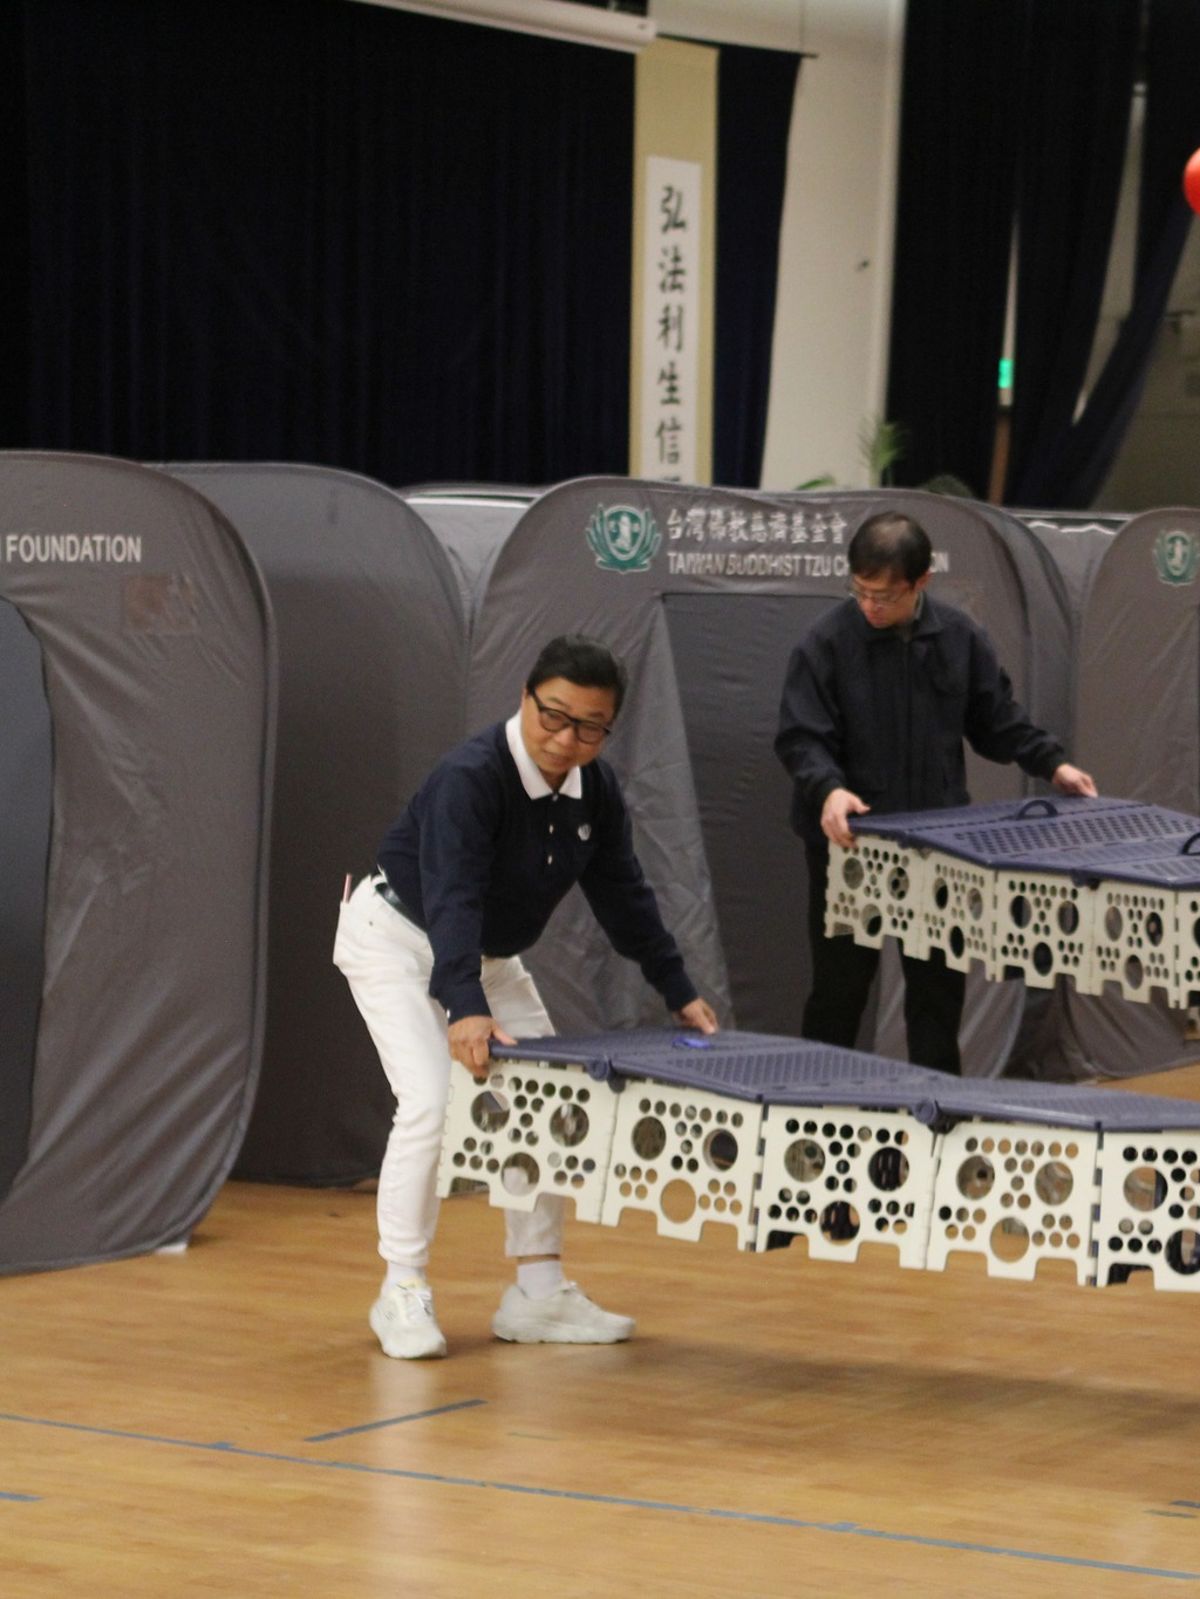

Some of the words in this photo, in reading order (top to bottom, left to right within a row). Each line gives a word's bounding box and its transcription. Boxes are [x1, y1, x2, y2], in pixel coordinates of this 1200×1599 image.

[657, 185, 687, 482] 弘法利生信
[6, 534, 142, 563] FOUNDATION
[667, 552, 725, 575] TAIWAN
[726, 553, 800, 577] BUDDHIST
[804, 555, 831, 577] TZU
